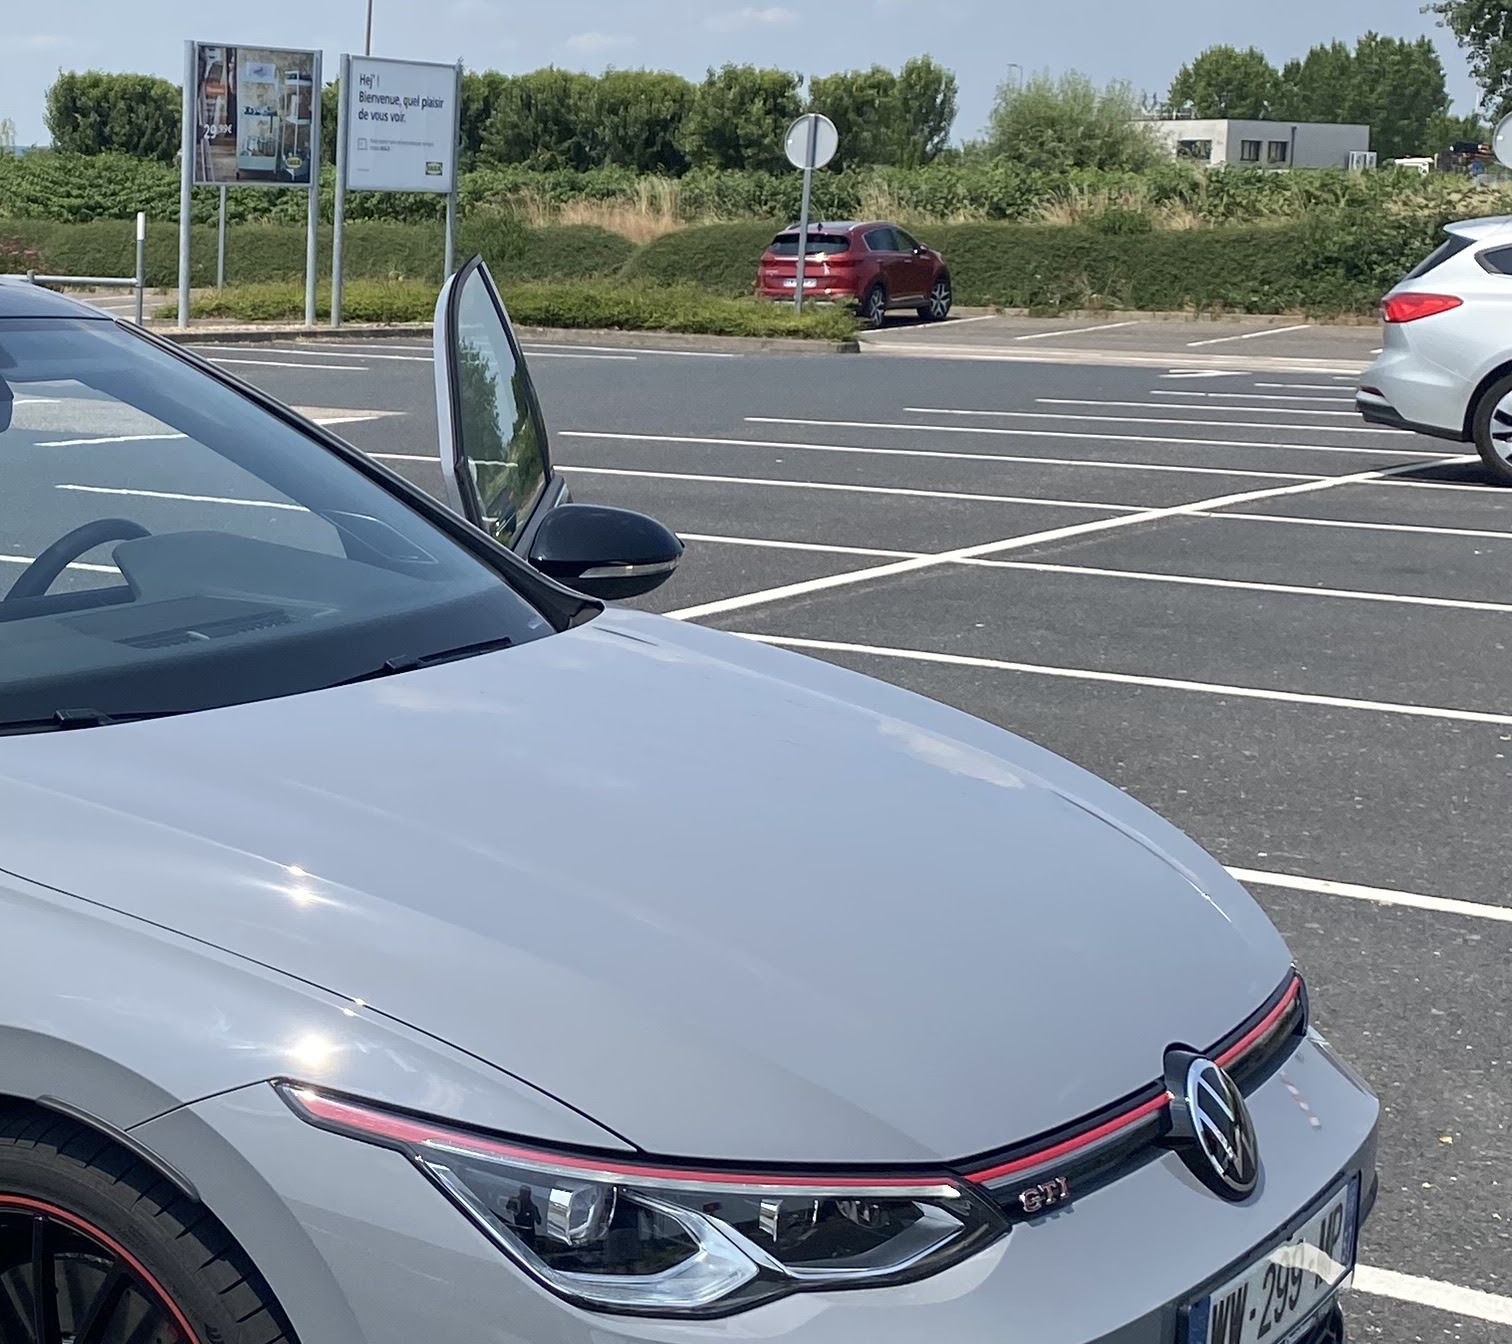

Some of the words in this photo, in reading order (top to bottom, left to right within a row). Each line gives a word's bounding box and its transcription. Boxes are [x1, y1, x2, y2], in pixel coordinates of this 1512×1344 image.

[359, 90, 402, 108] Bienvenue,
[402, 94, 420, 109] quel
[421, 96, 444, 110] plaisir
[358, 108, 370, 120] de
[370, 111, 389, 122] vous
[1018, 1176, 1070, 1213] GTI
